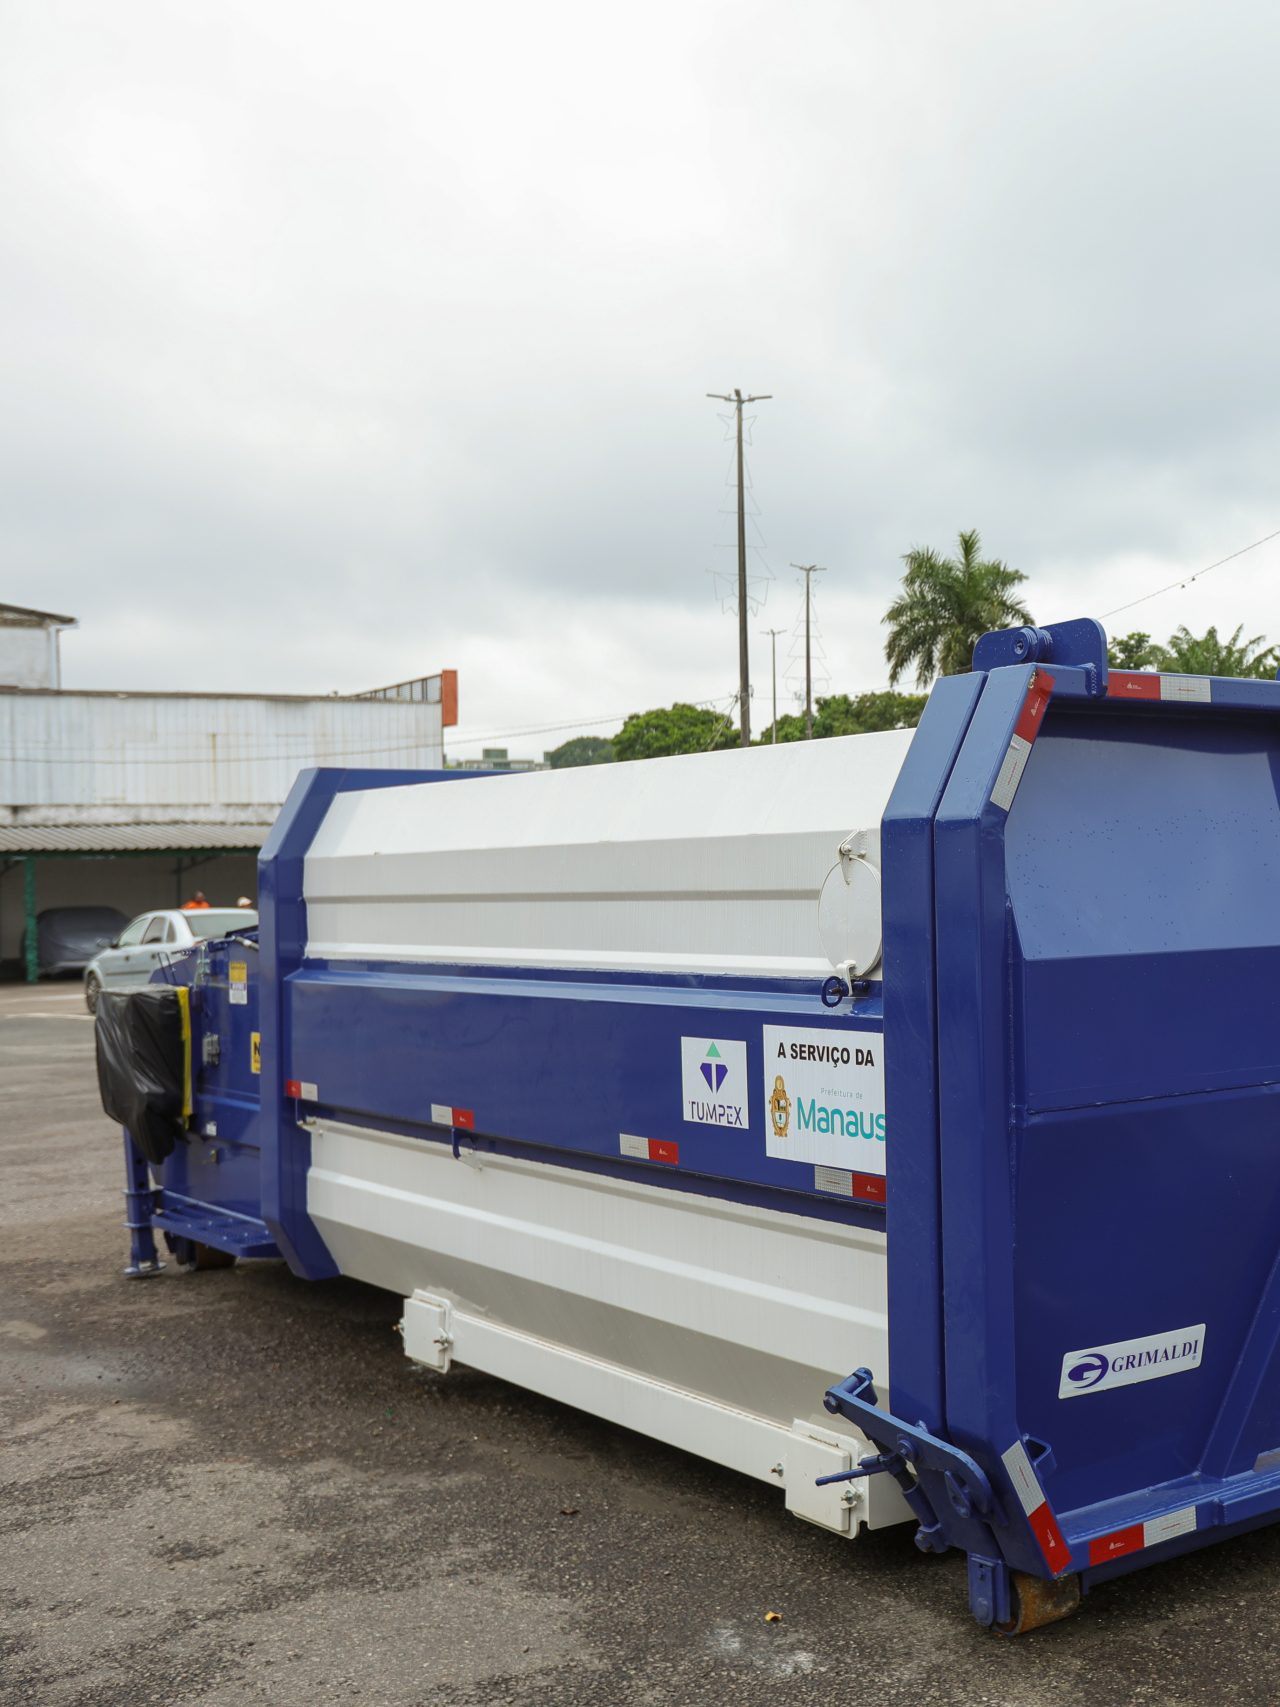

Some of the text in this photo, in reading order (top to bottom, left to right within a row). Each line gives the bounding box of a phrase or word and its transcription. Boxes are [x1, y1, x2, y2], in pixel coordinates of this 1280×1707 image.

[777, 1042, 875, 1068] A SERVIÇO DA
[820, 1087, 853, 1099] Prefeitura
[688, 1101, 743, 1126] TUMPEX
[797, 1096, 886, 1142] Manaus
[1111, 1339, 1199, 1373] GRIMALDI
